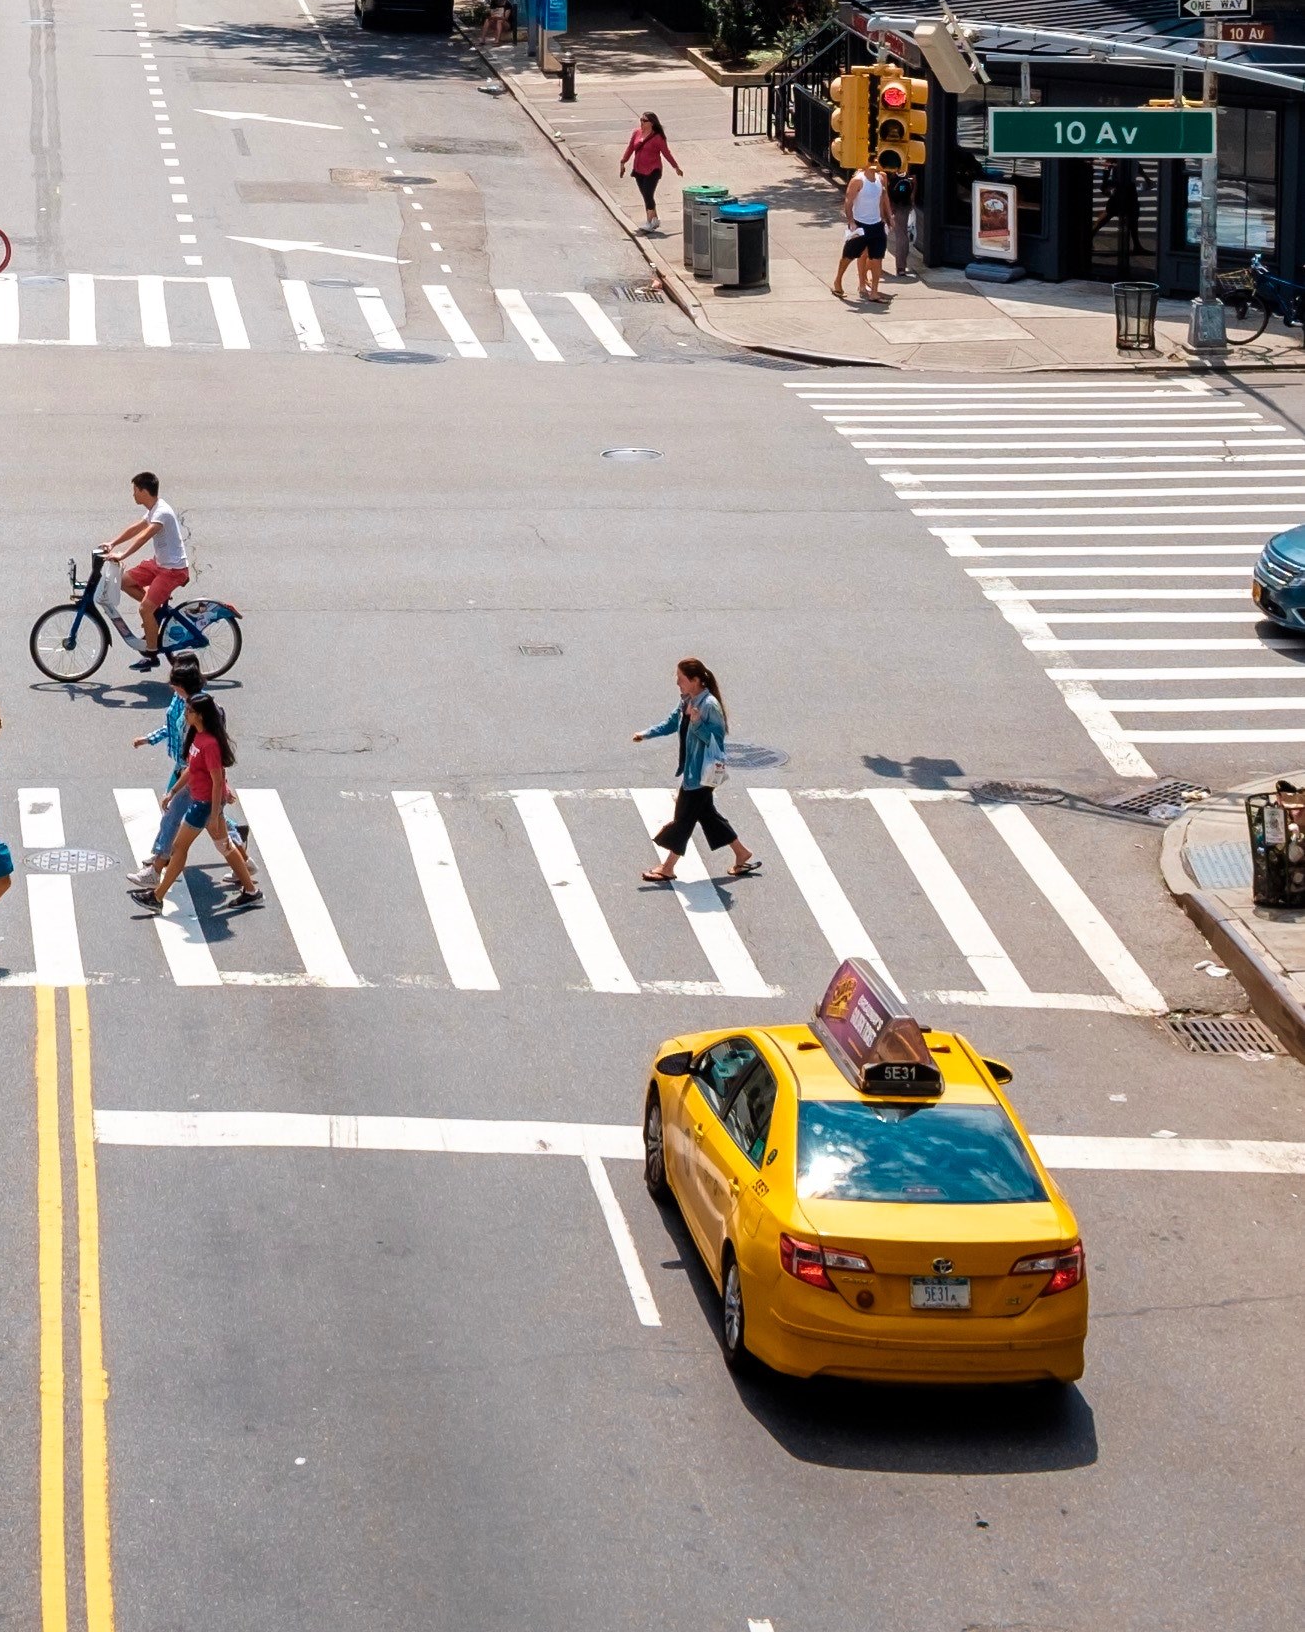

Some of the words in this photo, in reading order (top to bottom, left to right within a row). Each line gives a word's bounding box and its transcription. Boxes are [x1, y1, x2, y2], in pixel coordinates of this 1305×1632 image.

[1190, 0, 1211, 10] ONE
[1220, 0, 1243, 9] WAY
[1229, 28, 1244, 40] 10
[1248, 28, 1265, 40] Av
[1054, 121, 1086, 145] 10
[1096, 121, 1138, 145] Av
[884, 1066, 916, 1080] 5E31
